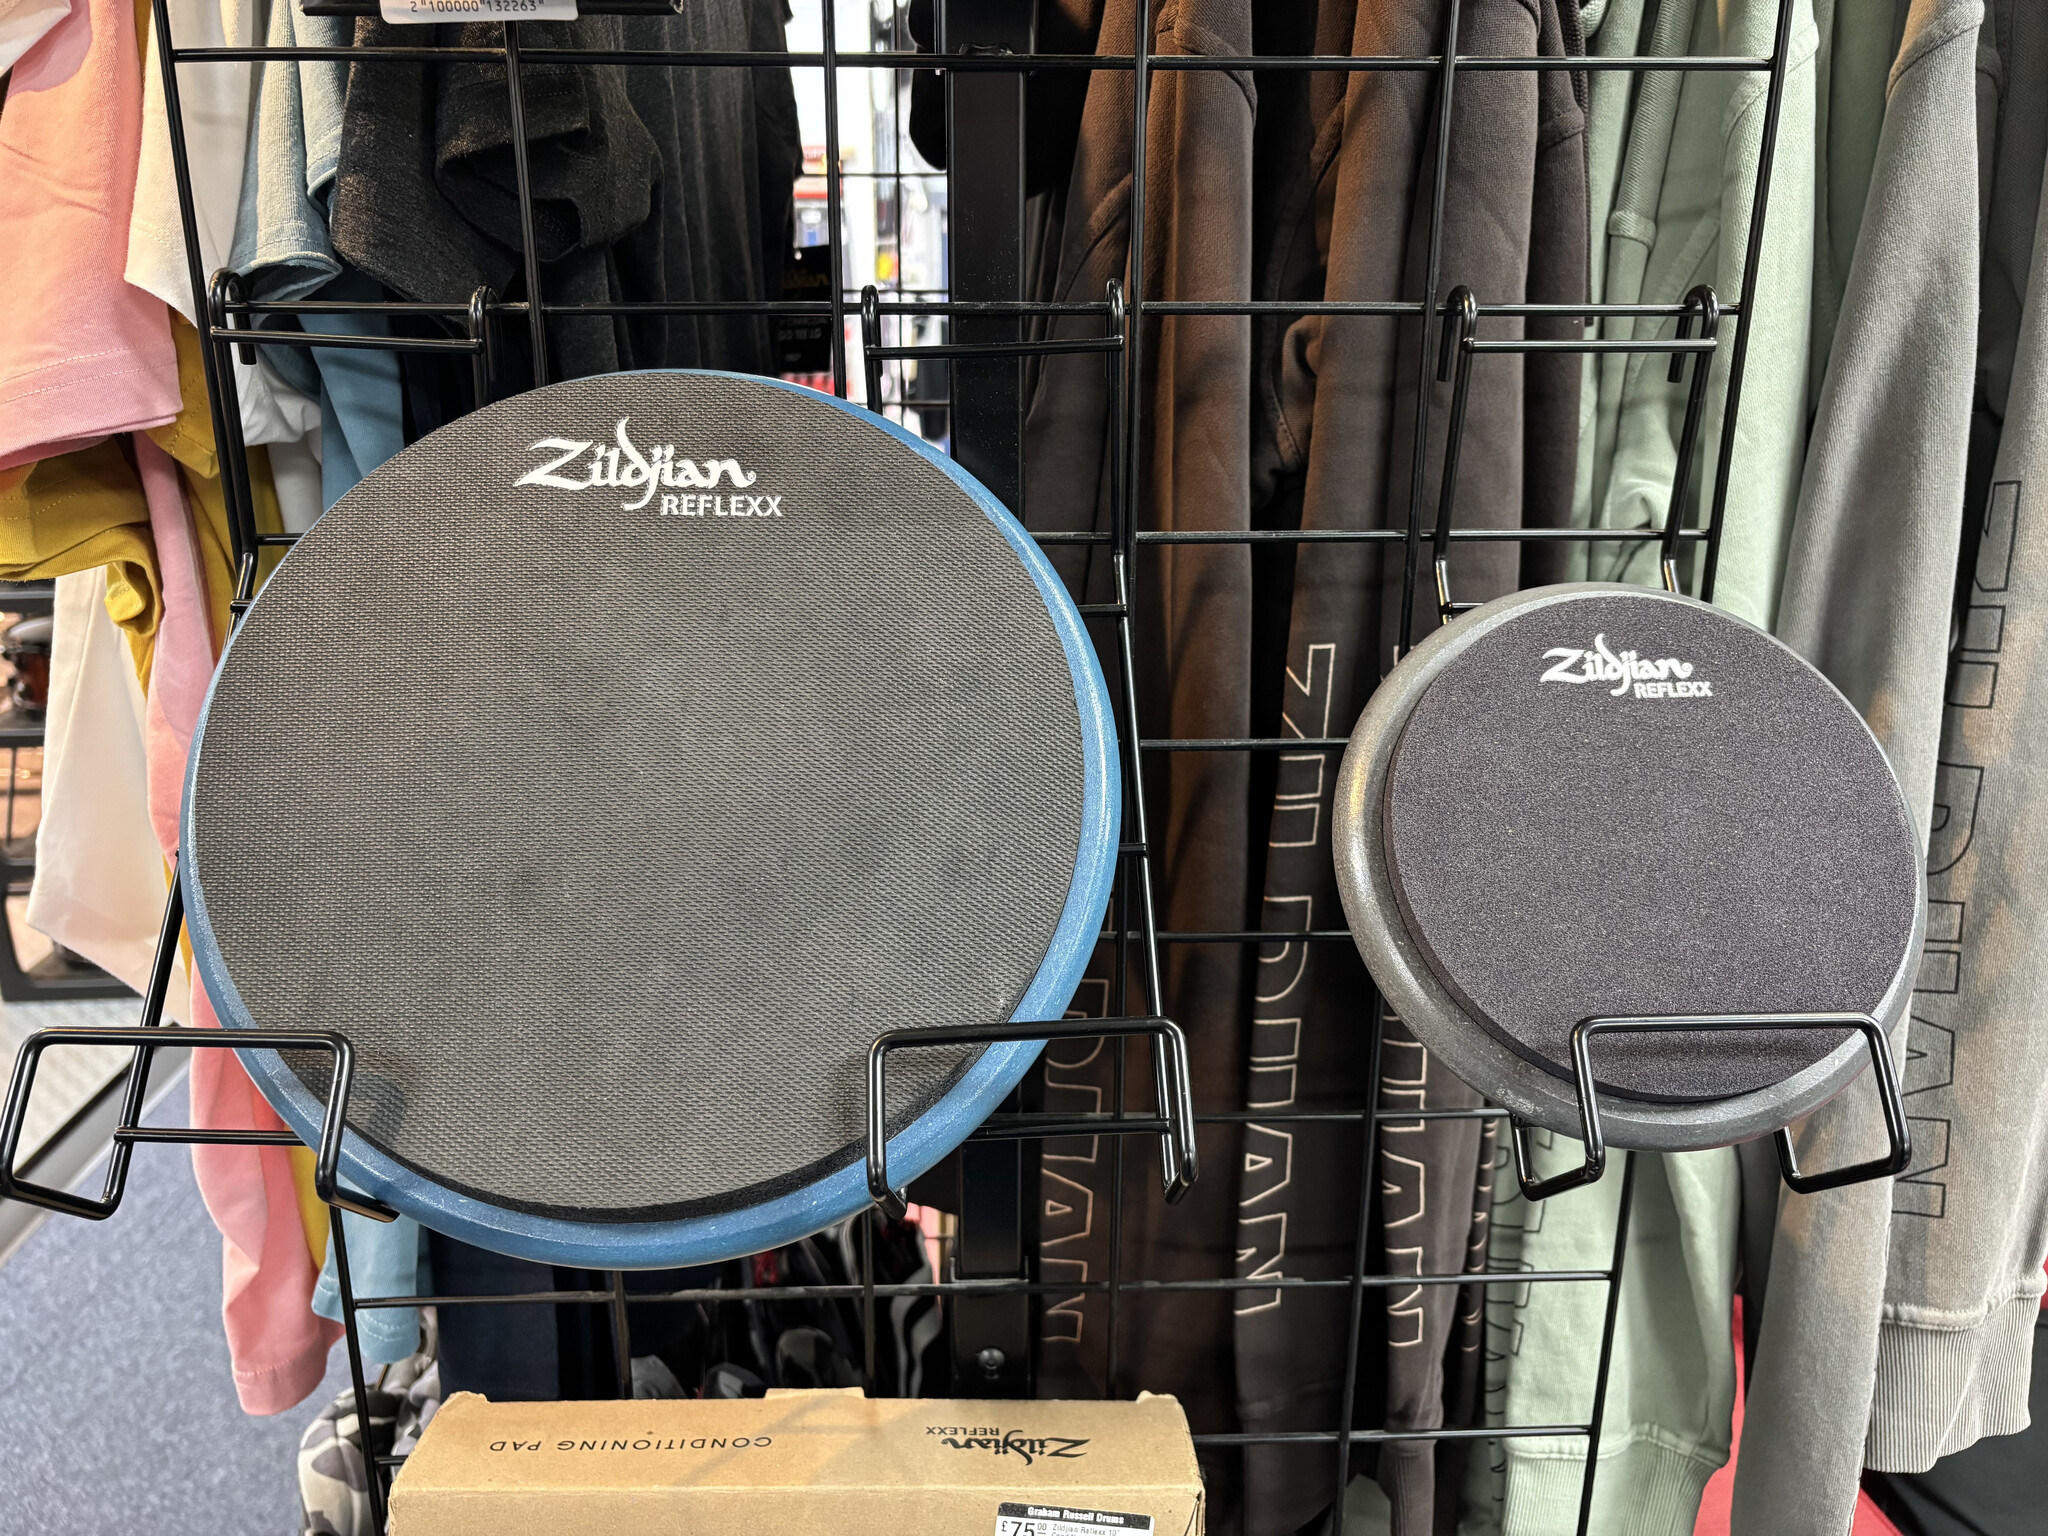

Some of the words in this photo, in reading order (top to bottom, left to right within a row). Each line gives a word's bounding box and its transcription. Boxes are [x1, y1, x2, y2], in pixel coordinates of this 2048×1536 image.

[513, 416, 756, 511] Zildjian
[660, 495, 782, 516] REFLEXX
[1540, 633, 1693, 696] Zildjian
[1634, 681, 1713, 698] REFLEXX
[926, 1426, 999, 1436] REFLEXX
[489, 1440, 542, 1451] PAD
[556, 1437, 772, 1451] CONDITIONING
[941, 1430, 1091, 1466] Zildjian
[1027, 1506, 1060, 1518] Graham
[1063, 1509, 1095, 1521] Russell
[1096, 1513, 1125, 1524] Drums
